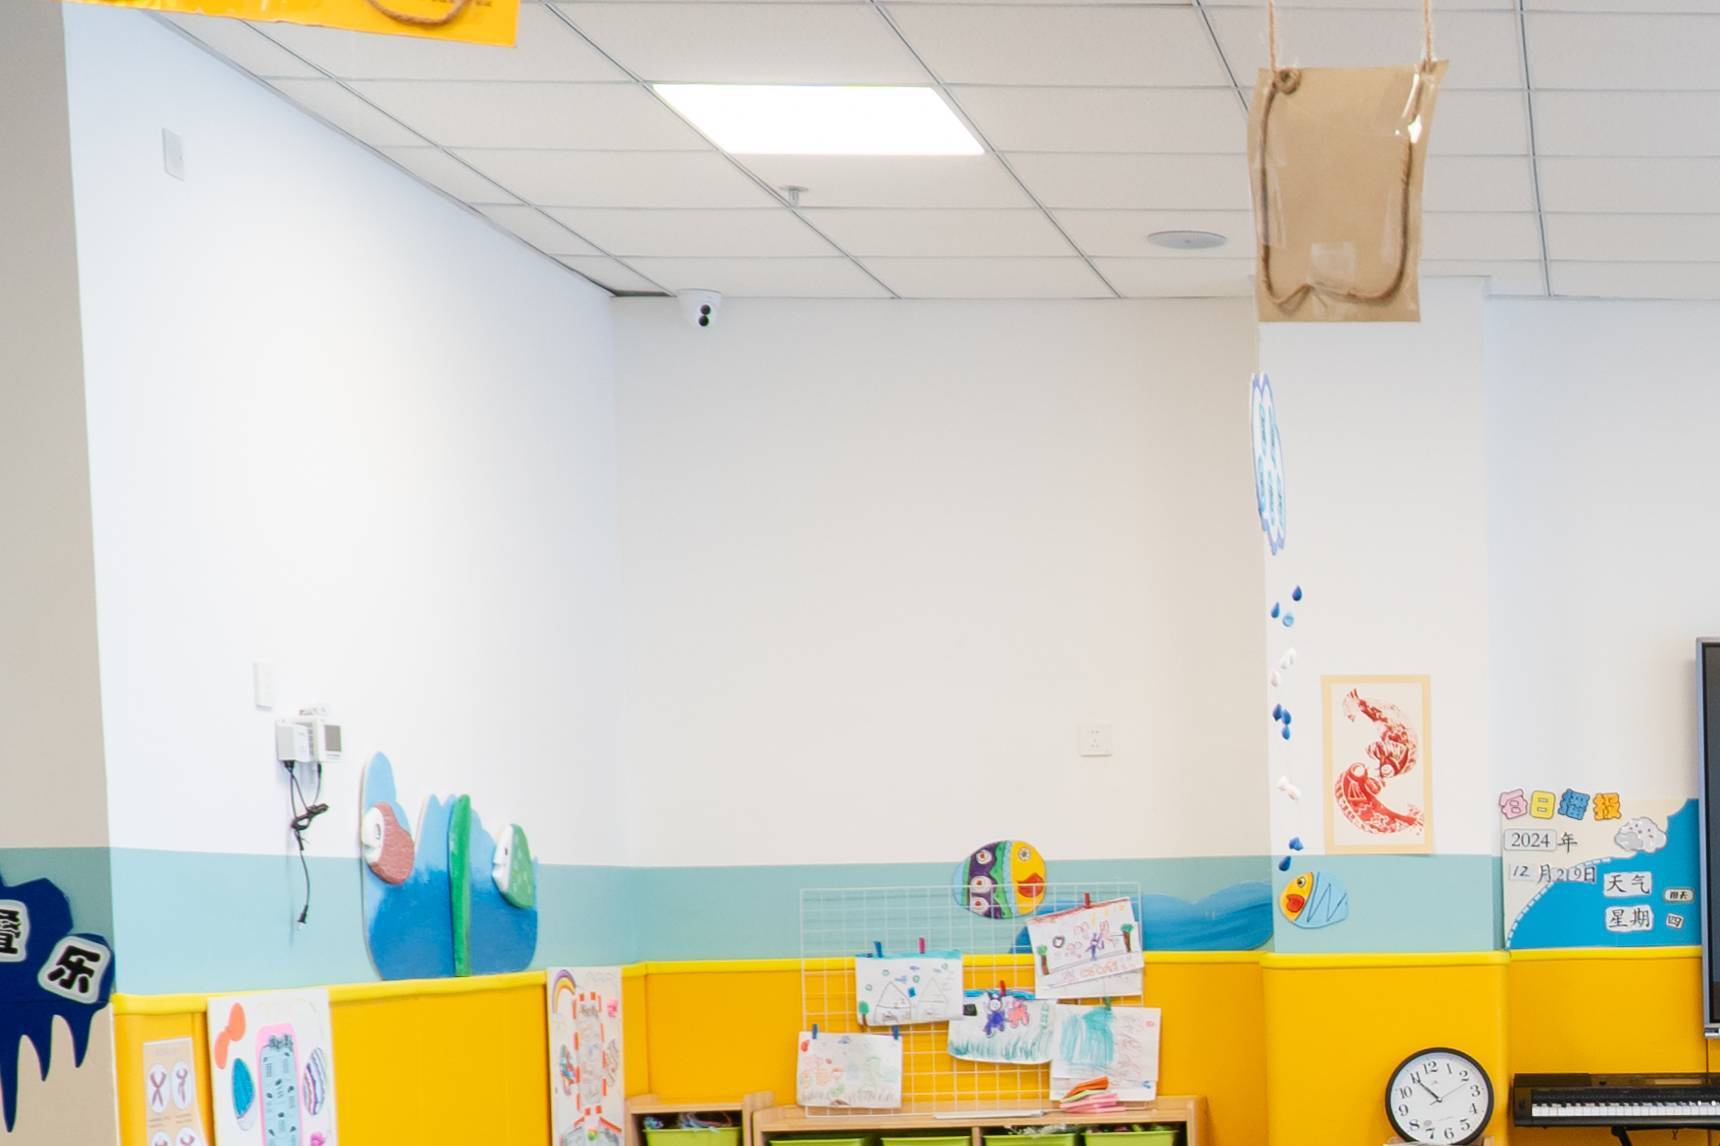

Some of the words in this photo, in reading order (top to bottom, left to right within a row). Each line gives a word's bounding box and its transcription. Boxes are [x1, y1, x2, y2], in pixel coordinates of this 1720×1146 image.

[1606, 873, 1650, 895] 天气
[1608, 909, 1651, 929] 星期
[1423, 1061, 1439, 1074] 12
[1446, 1064, 1453, 1075] 1
[1459, 1071, 1470, 1082] 2
[1400, 1087, 1413, 1099] 10
[1470, 1085, 1481, 1097] 3
[1398, 1105, 1409, 1117] 9
[1469, 1103, 1478, 1114] 4
[1409, 1119, 1420, 1131] 8
[1460, 1119, 1471, 1131] 5
[1425, 1128, 1436, 1140] 7
[1444, 1128, 1455, 1139] 6
